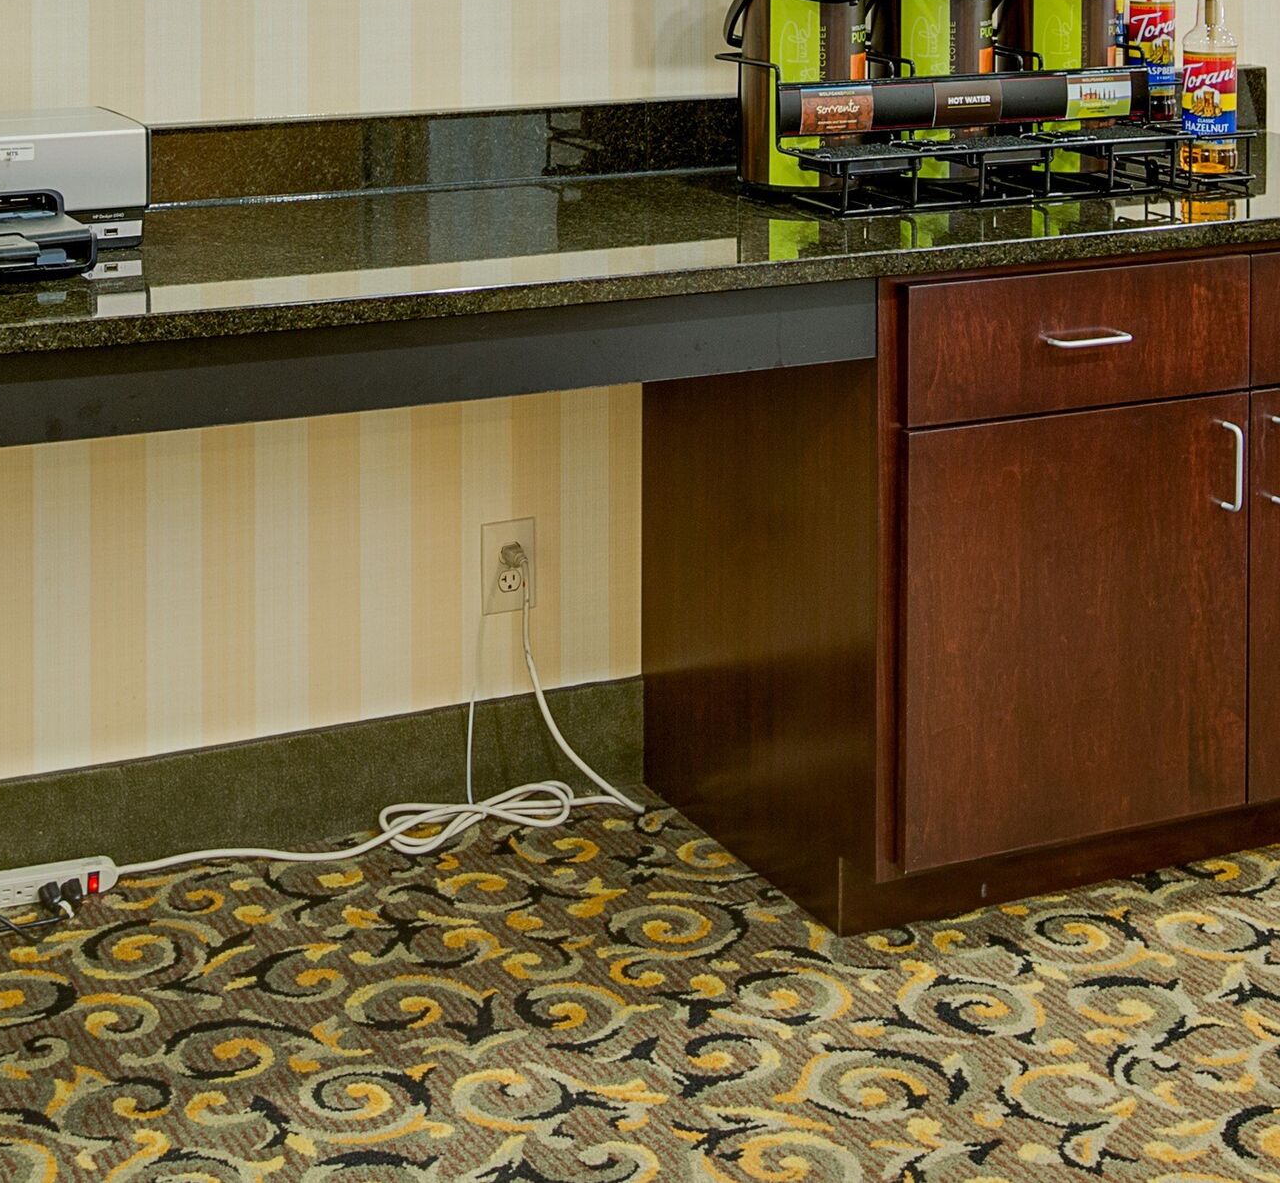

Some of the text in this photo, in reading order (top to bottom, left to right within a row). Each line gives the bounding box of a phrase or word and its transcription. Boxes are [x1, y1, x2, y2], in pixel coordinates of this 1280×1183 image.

[1130, 11, 1176, 46] Tora
[1183, 59, 1237, 94] Torani
[947, 94, 992, 105] HOT WATER
[1185, 120, 1230, 133] HAZELNUT
